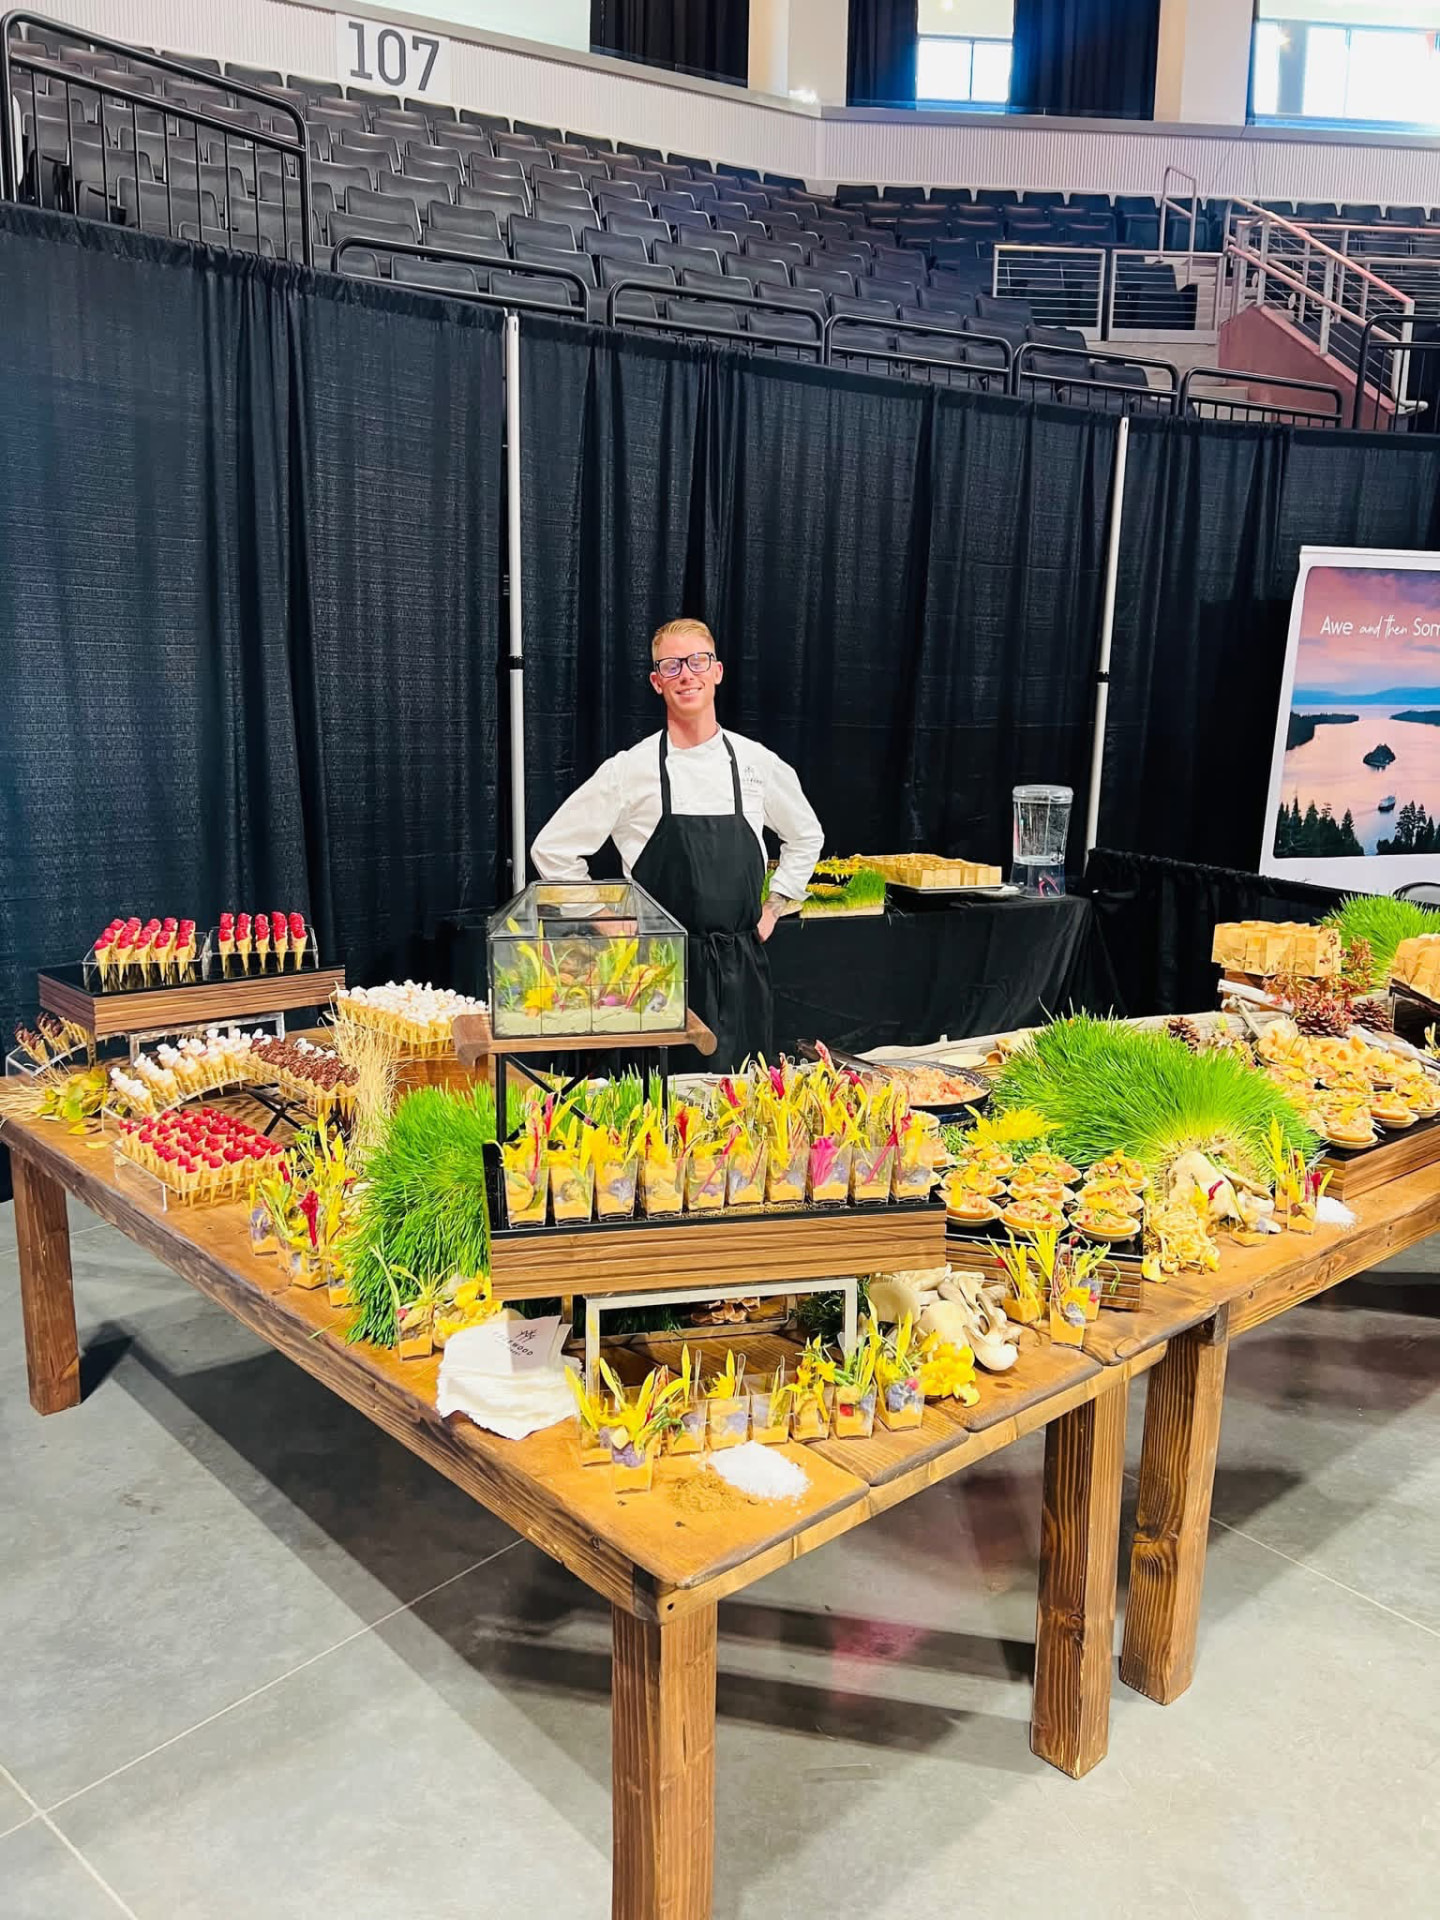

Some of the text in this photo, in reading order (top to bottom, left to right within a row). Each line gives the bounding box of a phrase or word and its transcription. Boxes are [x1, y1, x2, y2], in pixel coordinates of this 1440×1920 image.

[348, 21, 440, 91] 107
[1320, 615, 1354, 636] Awe
[1359, 616, 1384, 638] and
[1383, 614, 1408, 639] then
